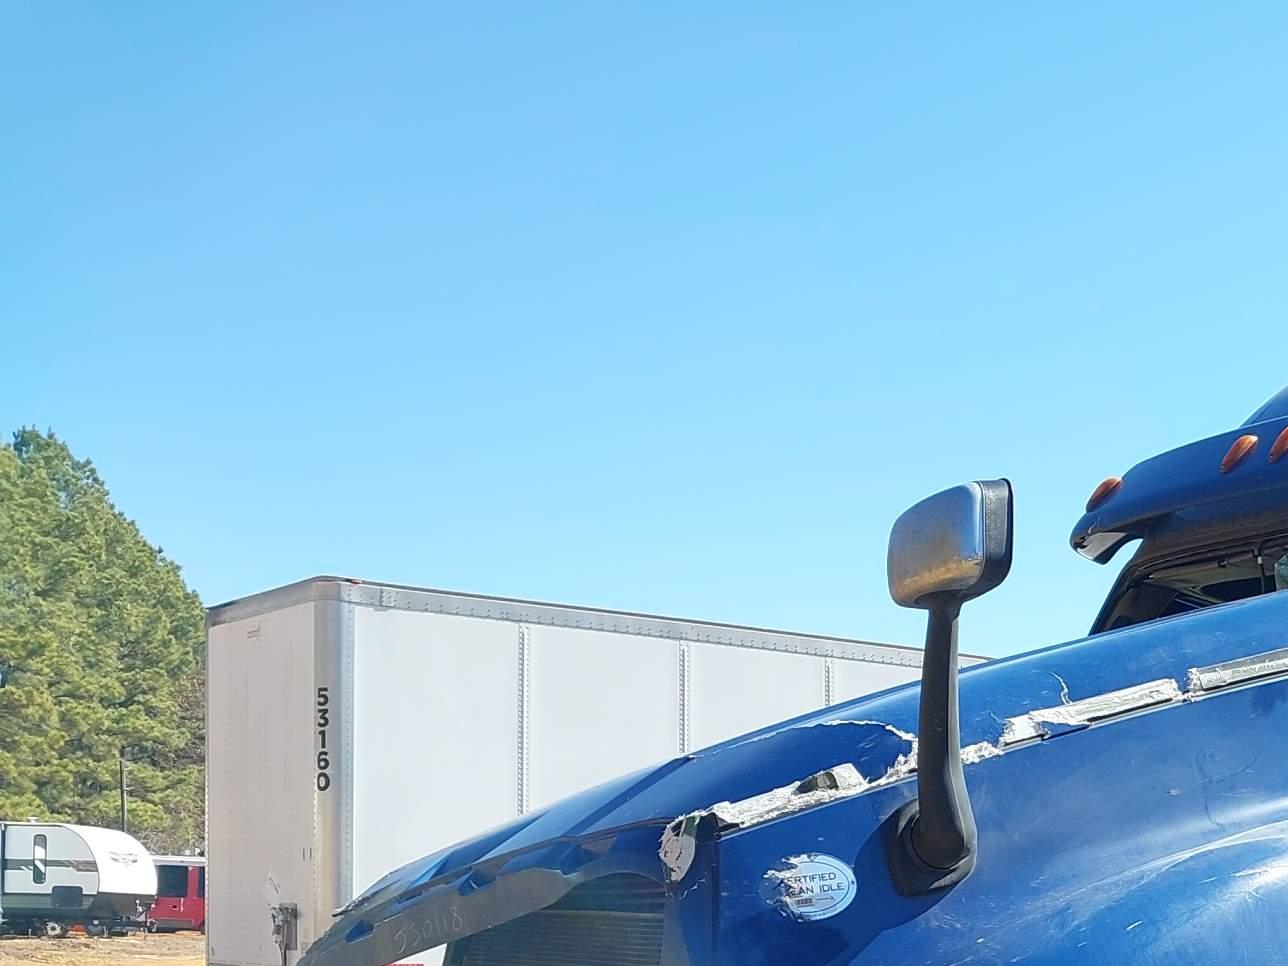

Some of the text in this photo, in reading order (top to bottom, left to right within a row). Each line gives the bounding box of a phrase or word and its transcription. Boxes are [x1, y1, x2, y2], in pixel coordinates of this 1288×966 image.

[316, 686, 331, 792] 53160
[786, 872, 837, 884] ERTIFIED
[819, 882, 845, 894] IDLE
